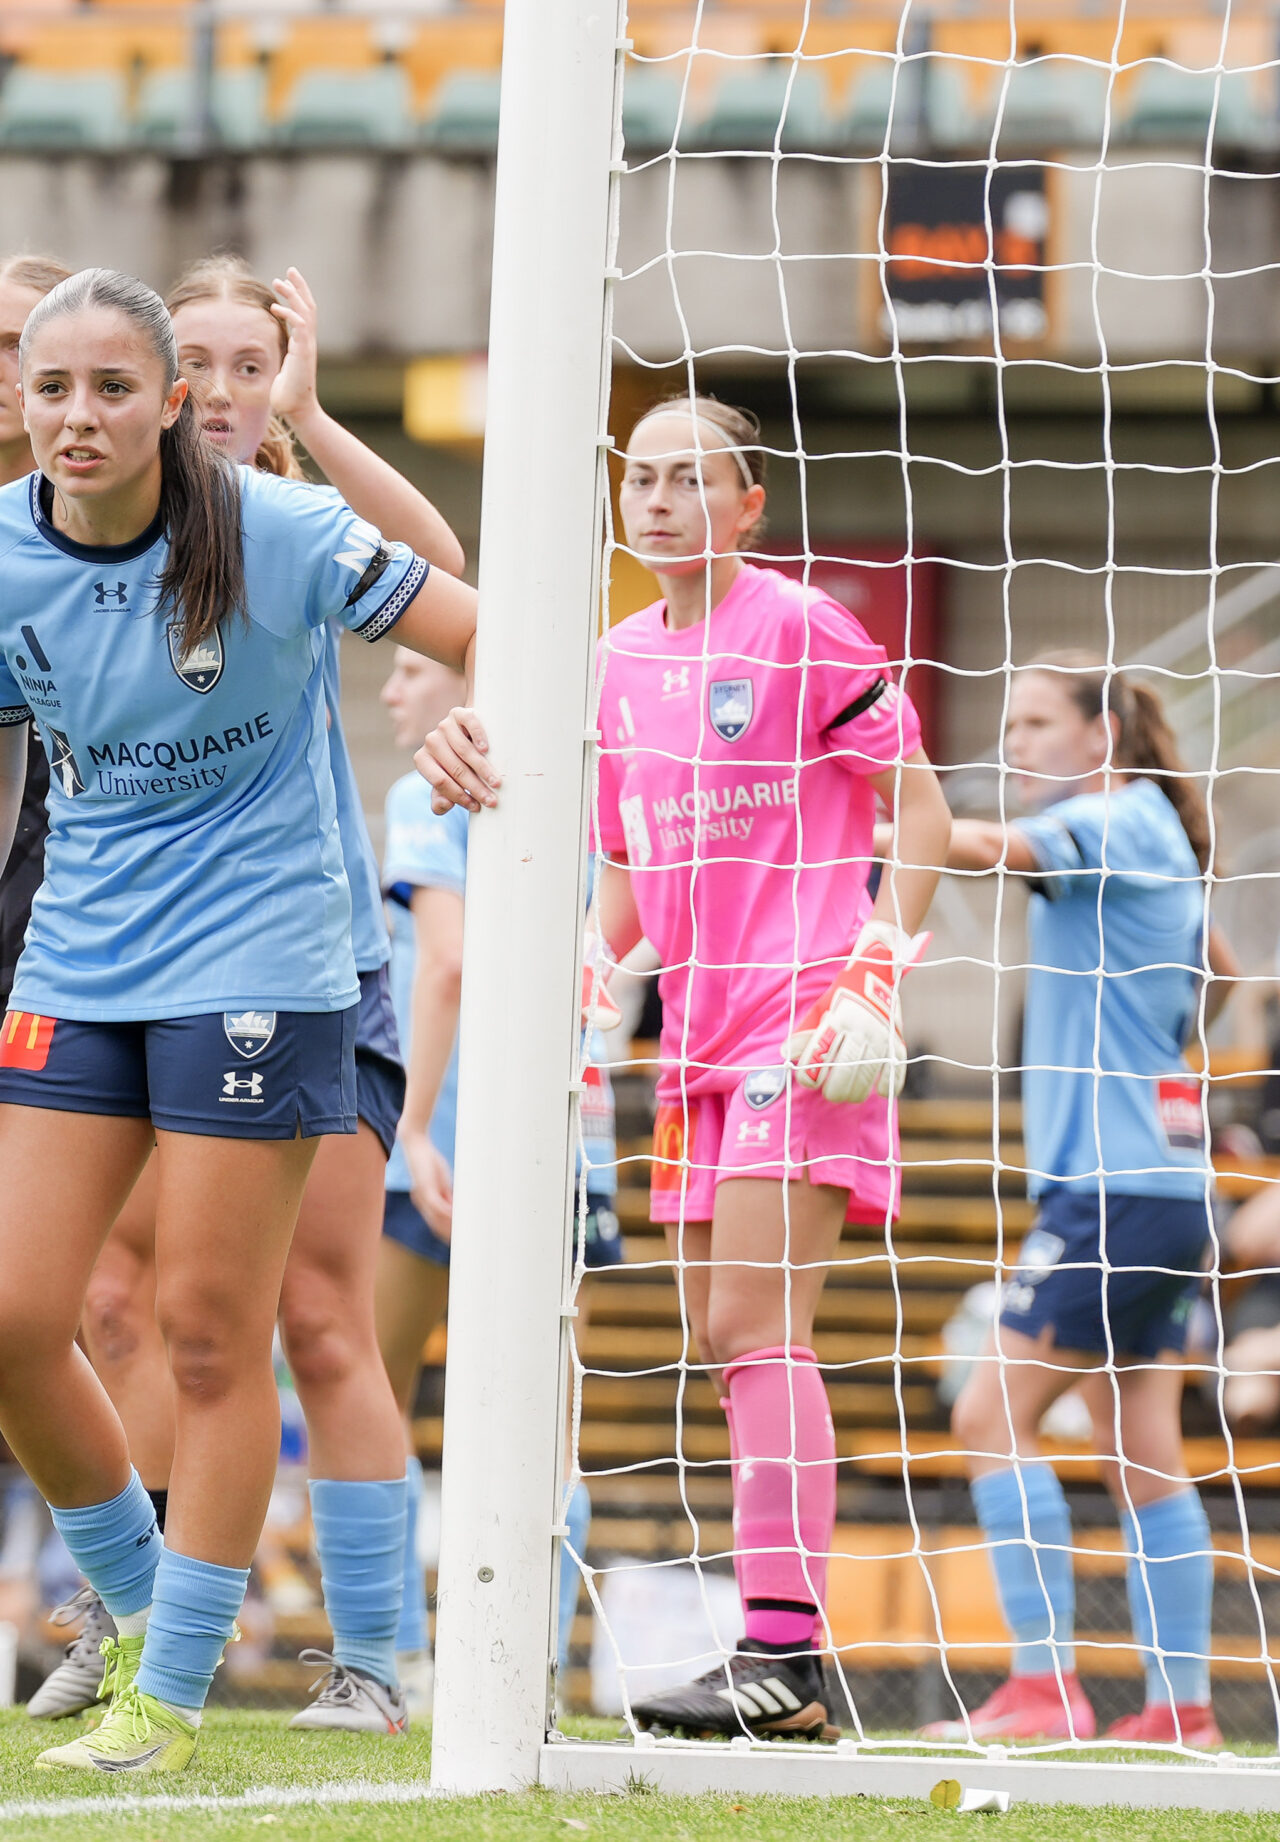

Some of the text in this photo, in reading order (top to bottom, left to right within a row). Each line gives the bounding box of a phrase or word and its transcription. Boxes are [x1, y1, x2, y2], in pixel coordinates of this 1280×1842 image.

[20, 672, 58, 697] NINJA
[87, 711, 274, 771] MACQUARIE
[97, 764, 228, 797] University
[652, 778, 797, 826] MACQUARIE
